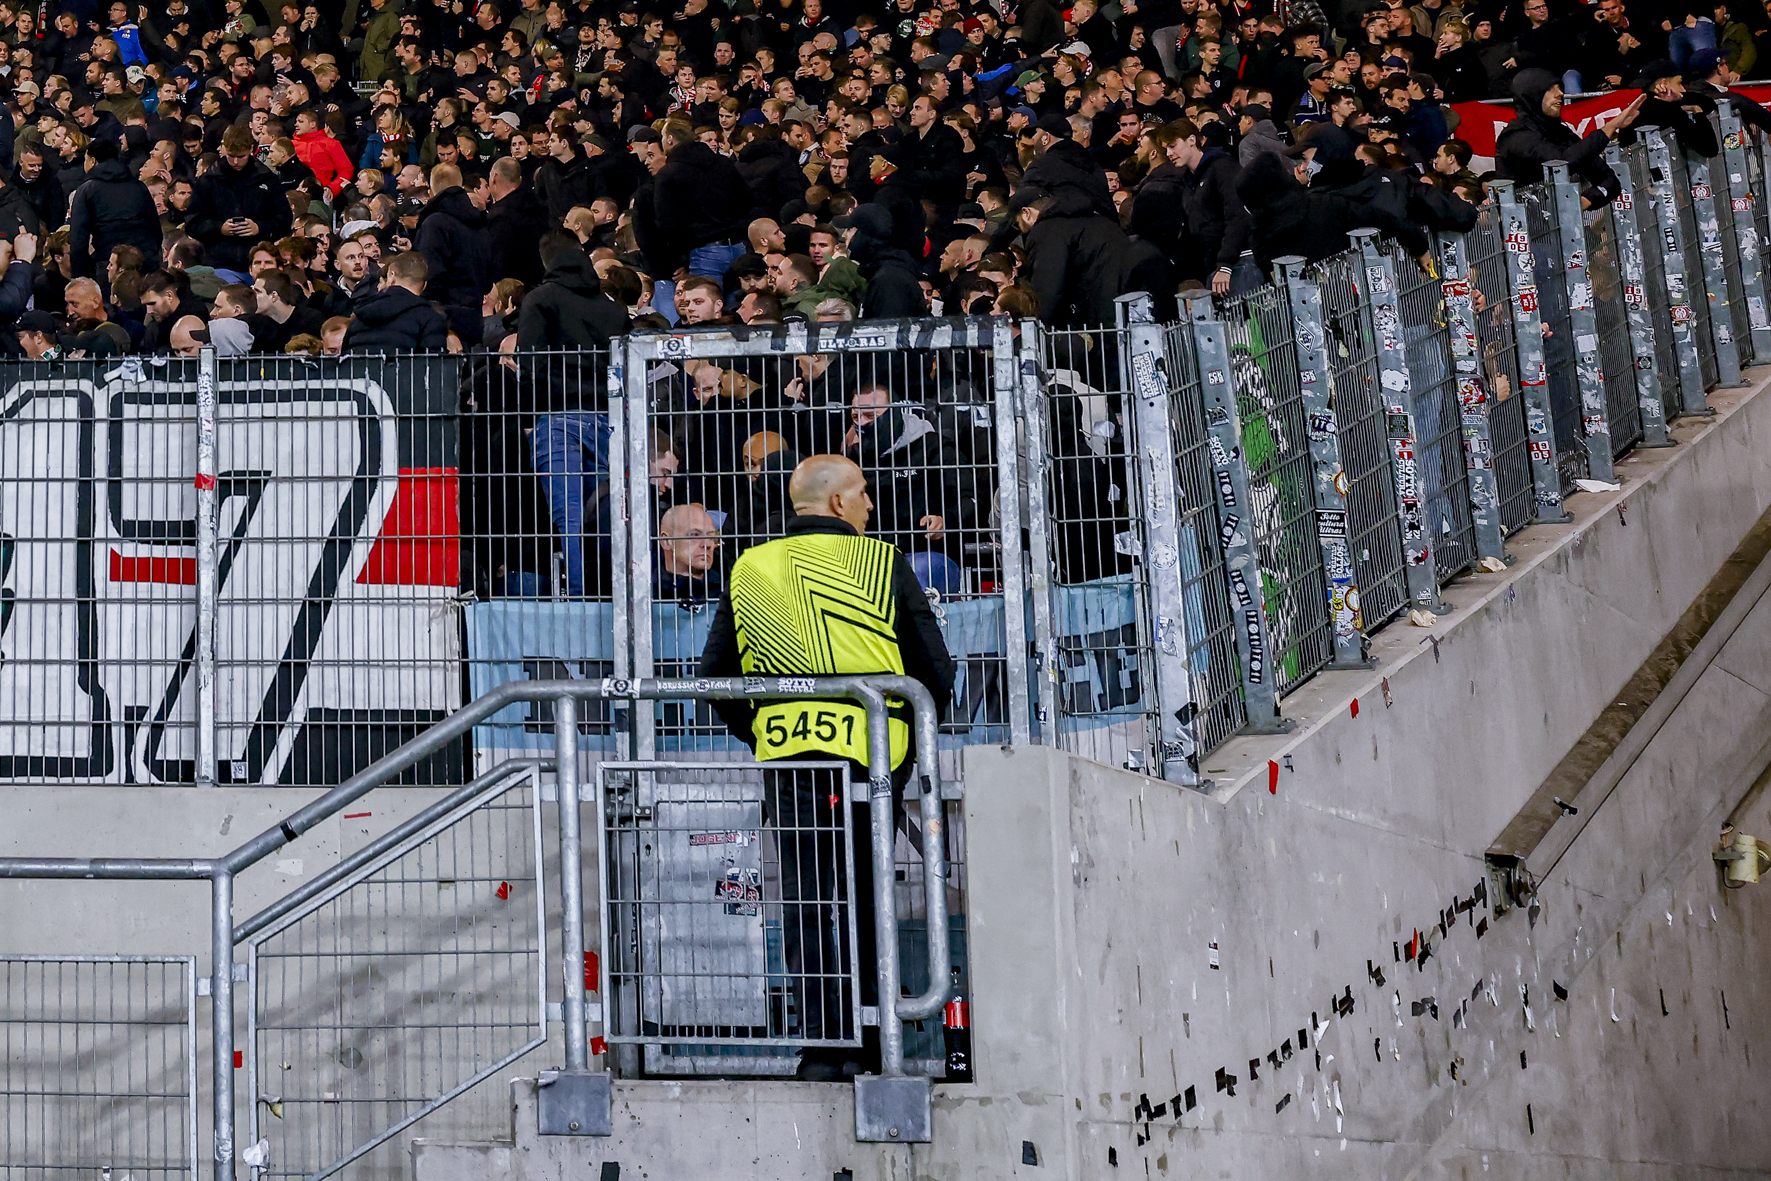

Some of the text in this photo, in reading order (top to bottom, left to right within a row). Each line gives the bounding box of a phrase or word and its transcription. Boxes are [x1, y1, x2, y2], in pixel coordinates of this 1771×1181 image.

[1510, 233, 1527, 243] 19
[1531, 442, 1549, 451] 19
[1405, 459, 1415, 498] SOTTO
[1336, 545, 1344, 575] SOTTO
[778, 677, 816, 687] SOTTO
[765, 710, 855, 748] 5451
